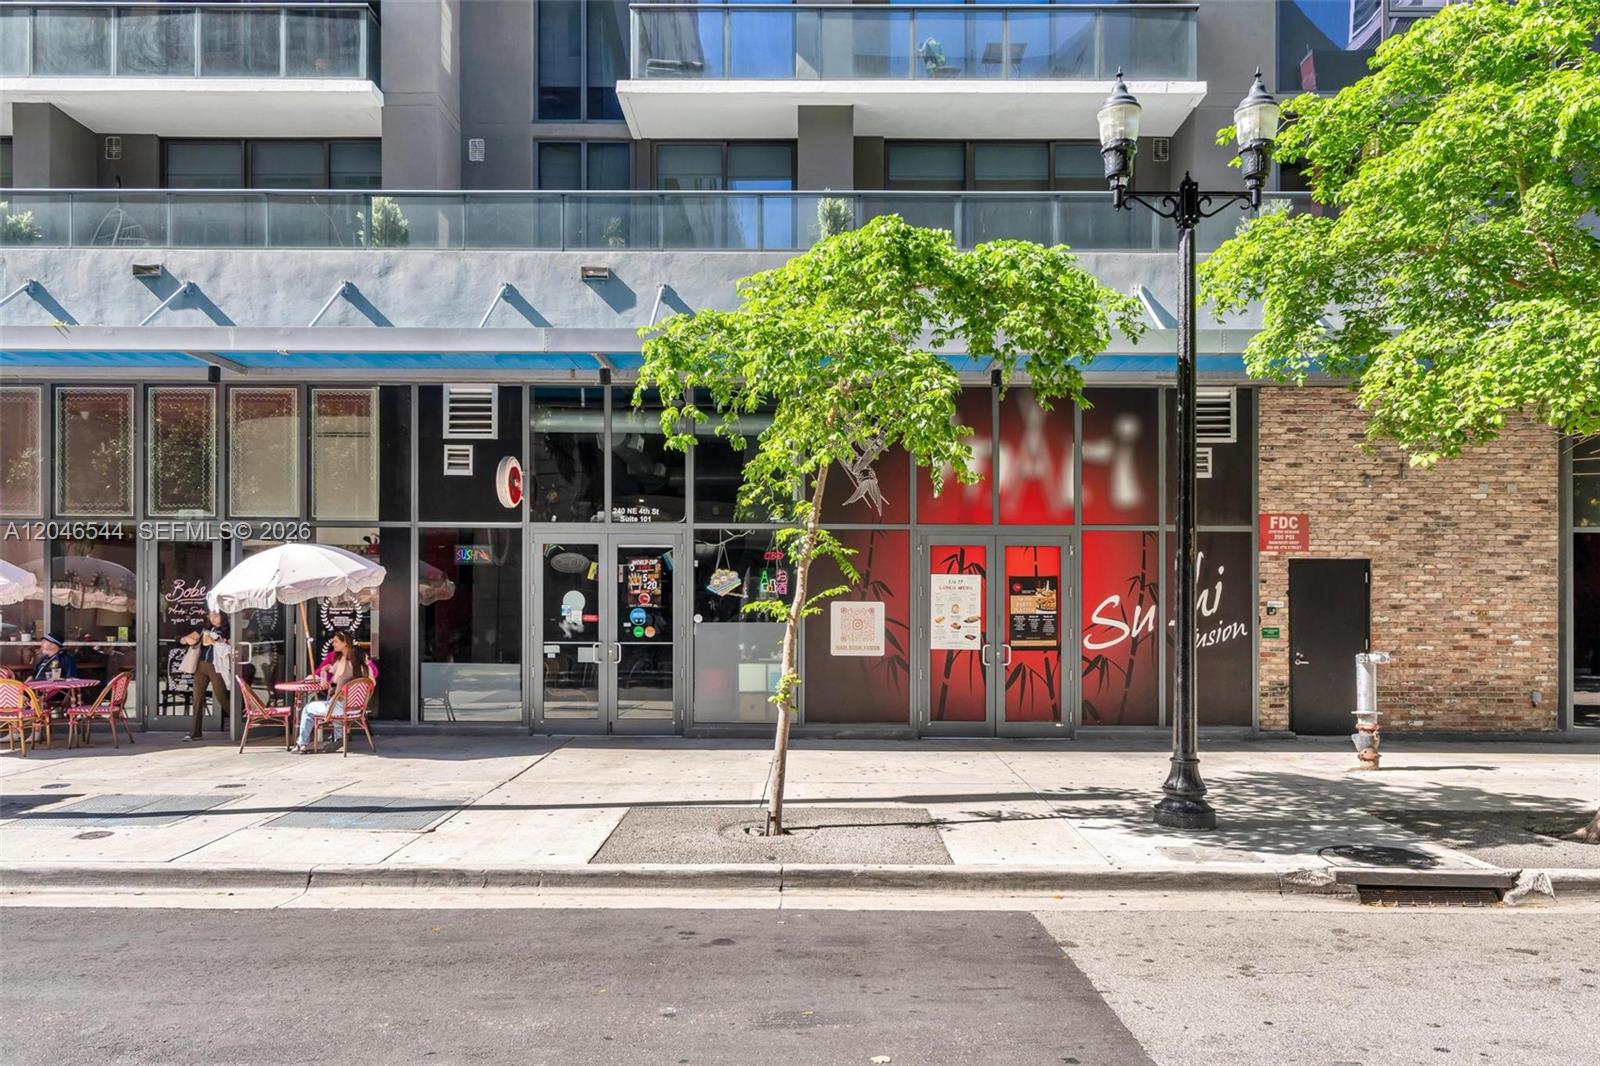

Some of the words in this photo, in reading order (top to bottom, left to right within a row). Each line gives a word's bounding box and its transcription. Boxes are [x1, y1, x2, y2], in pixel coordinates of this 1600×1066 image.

[1270, 516, 1298, 529] FDC
[643, 574, 648, 582] 5
[1083, 551, 1225, 650] Suhi
[1196, 620, 1248, 649] usion
